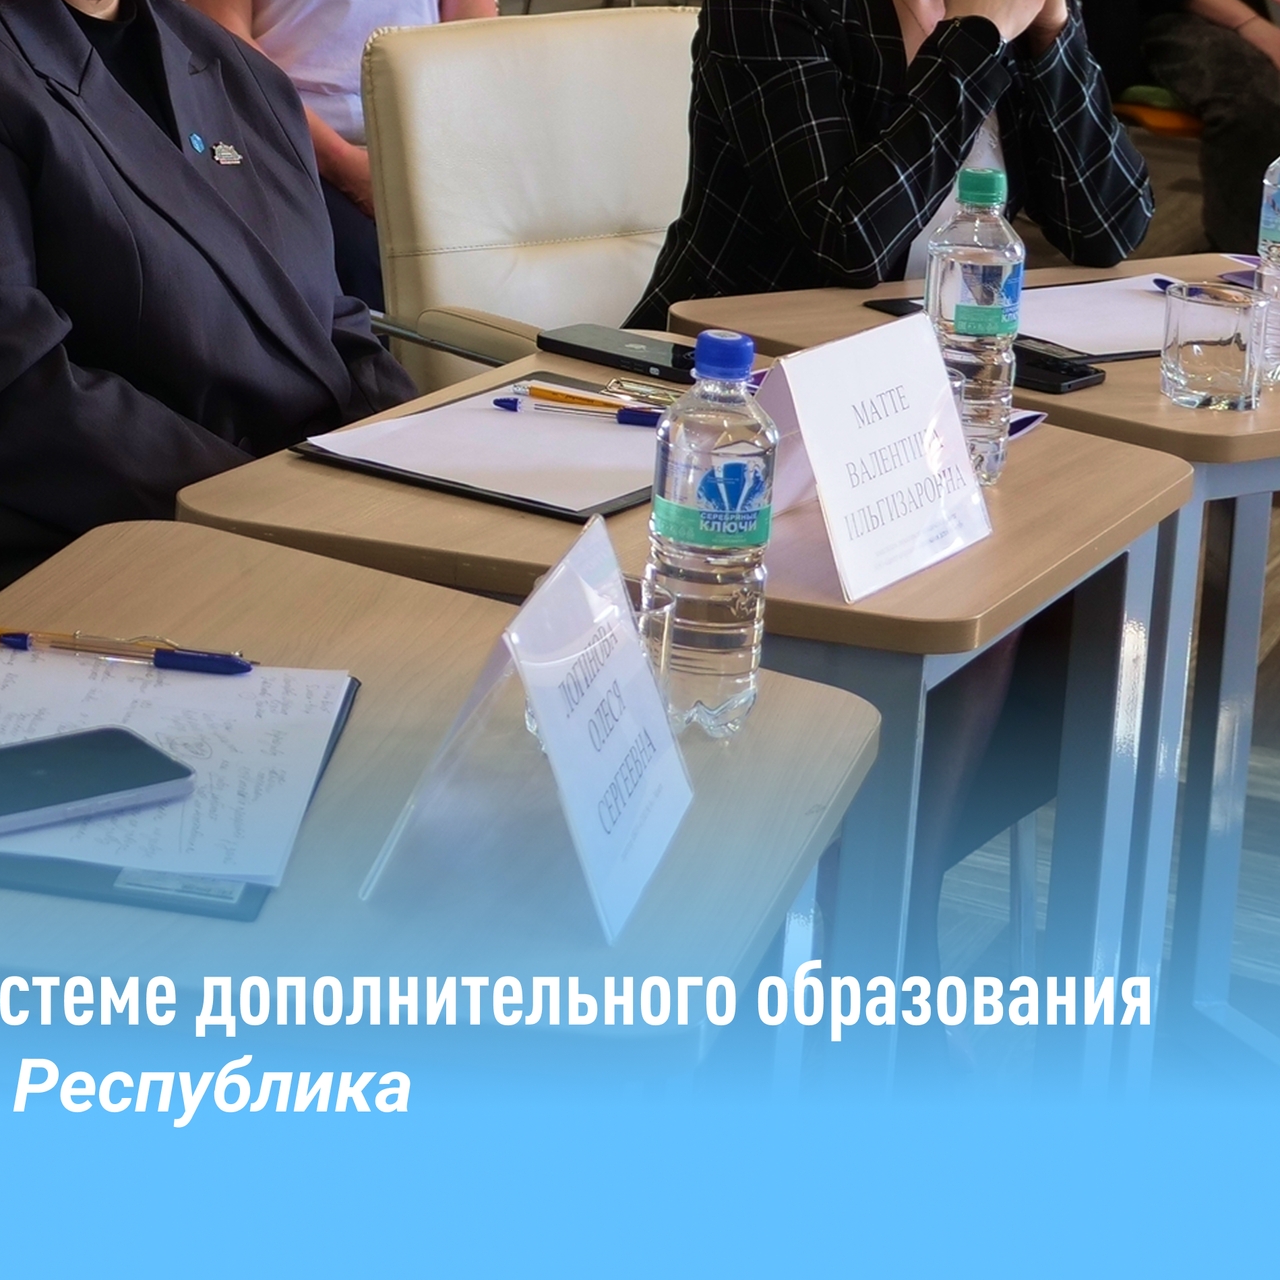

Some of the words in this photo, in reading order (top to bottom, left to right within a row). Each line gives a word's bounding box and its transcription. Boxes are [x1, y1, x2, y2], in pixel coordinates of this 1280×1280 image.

[851, 385, 910, 429] МАТТЕ
[699, 519, 758, 534] КЛЮЧИ
[558, 622, 619, 718] ЛОГИНОВА
[587, 678, 627, 753] ОЛЕСЯ
[596, 726, 658, 836] СЕРГЕЕВНА
